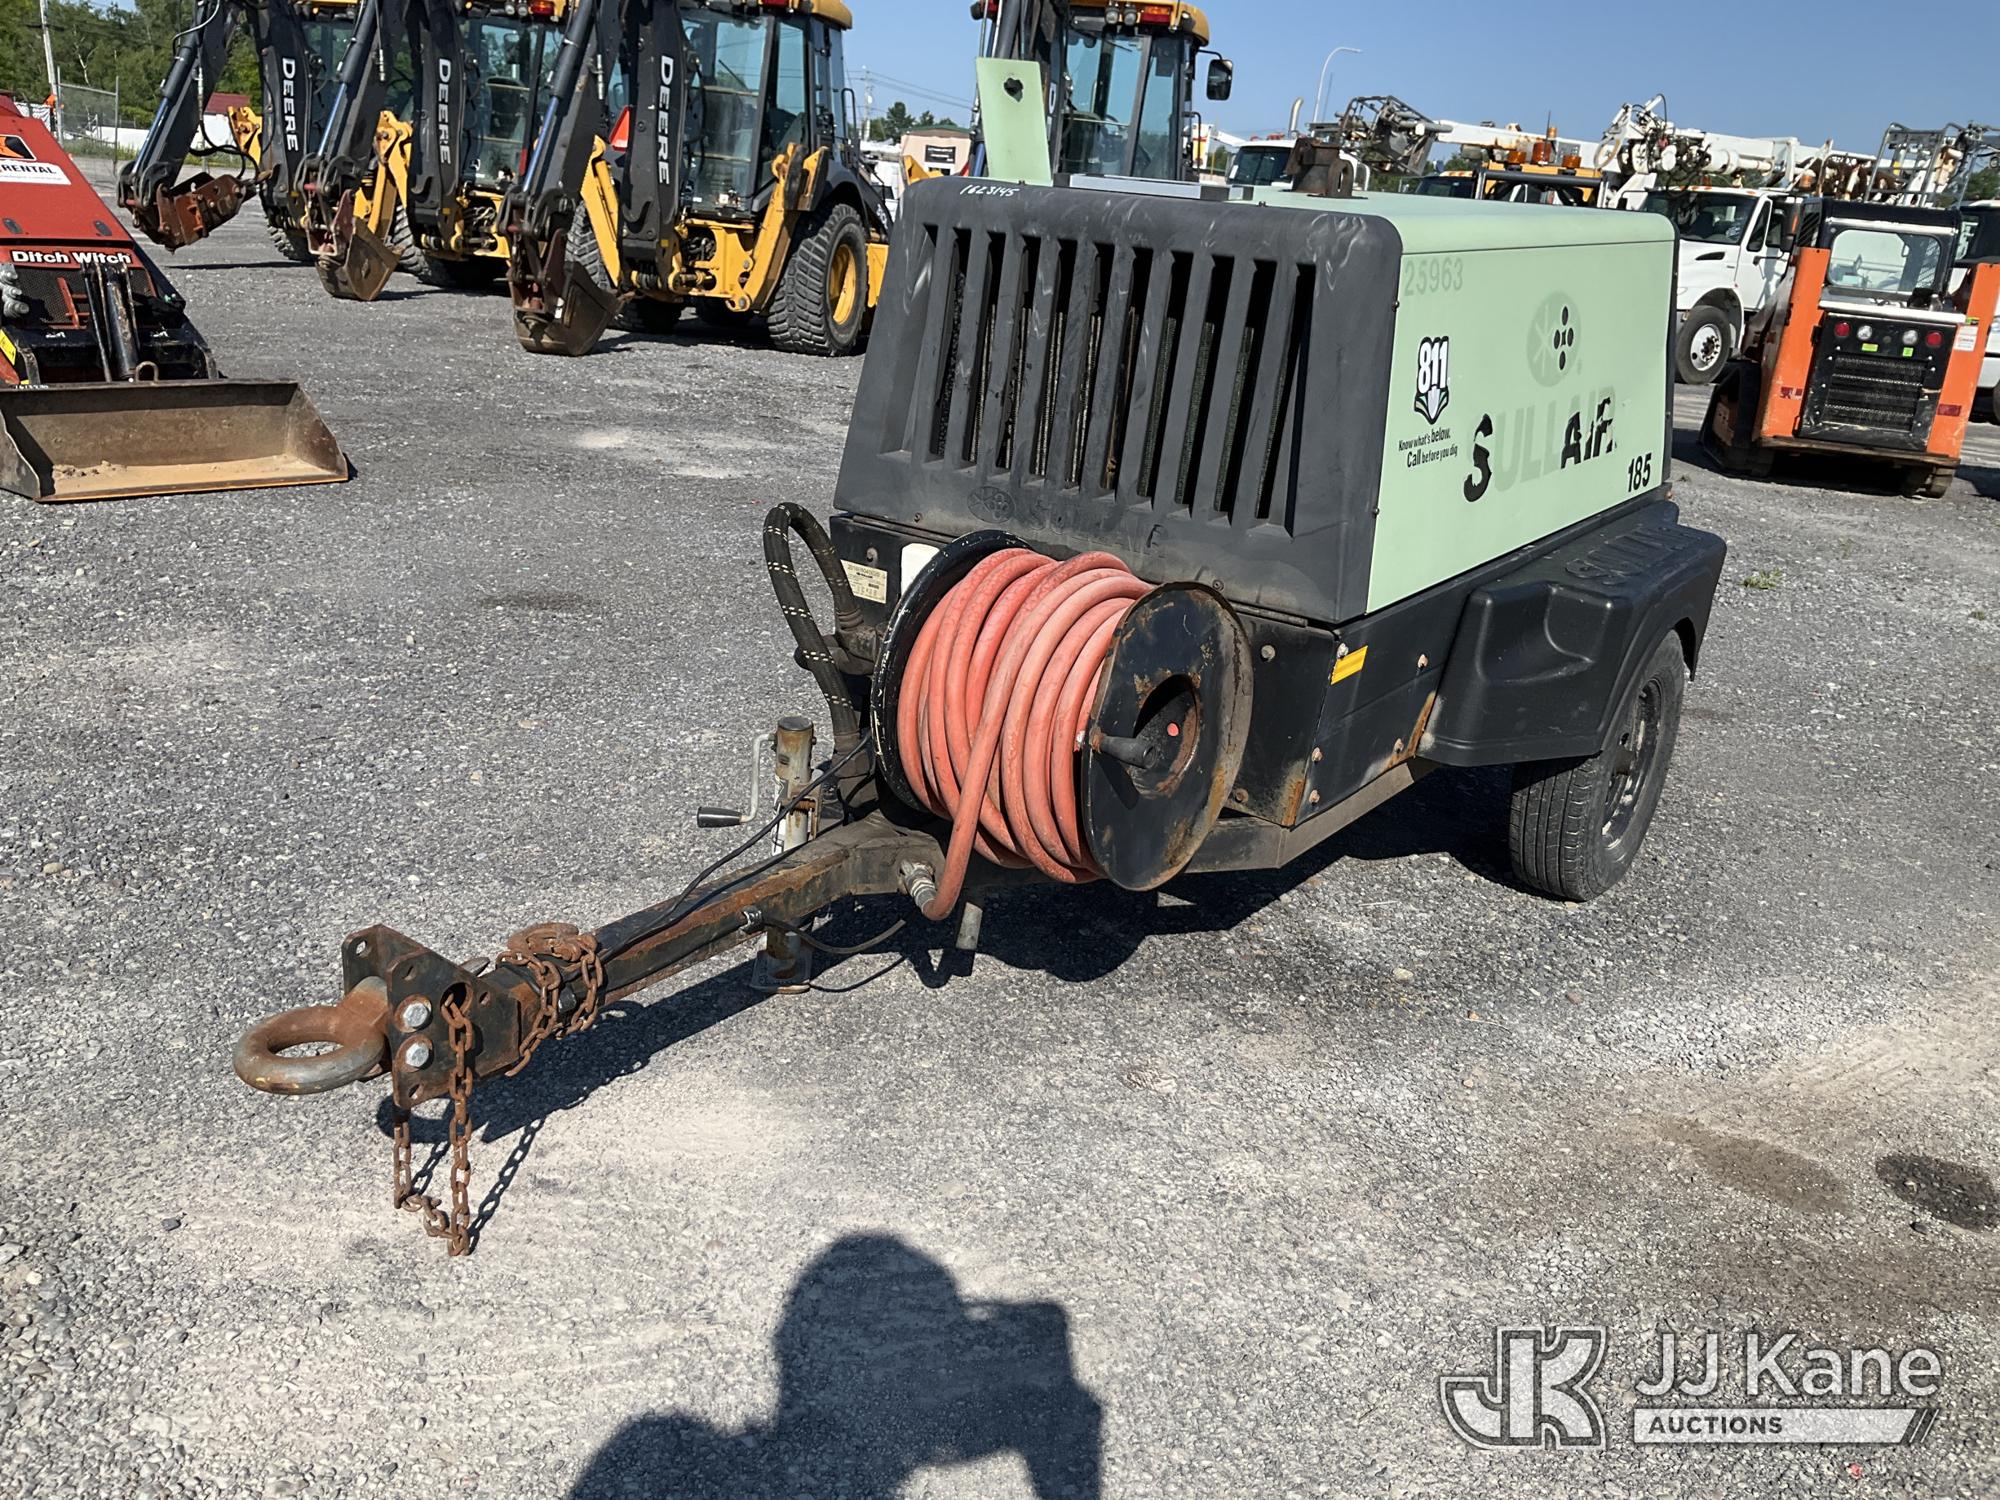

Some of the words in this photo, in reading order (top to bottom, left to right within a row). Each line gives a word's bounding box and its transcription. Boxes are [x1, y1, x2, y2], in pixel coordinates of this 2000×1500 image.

[282, 57, 299, 151] DEERE
[438, 58, 452, 164] DEERE
[658, 55, 674, 185] DEERE
[0, 164, 57, 175] RENTAL
[959, 184, 1020, 197] 1623145
[11, 250, 69, 263] Ditch
[72, 251, 133, 264] Witch
[1403, 257, 1464, 297] 25963
[1417, 338, 1449, 394] 811
[1398, 440, 1413, 451] Know
[1413, 433, 1430, 447] what's
[1431, 427, 1450, 442] below.
[1407, 449, 1421, 467] Call
[1422, 450, 1439, 463] before
[1439, 448, 1449, 461] you
[1449, 444, 1457, 457] dig
[1627, 452, 1653, 493] 185
